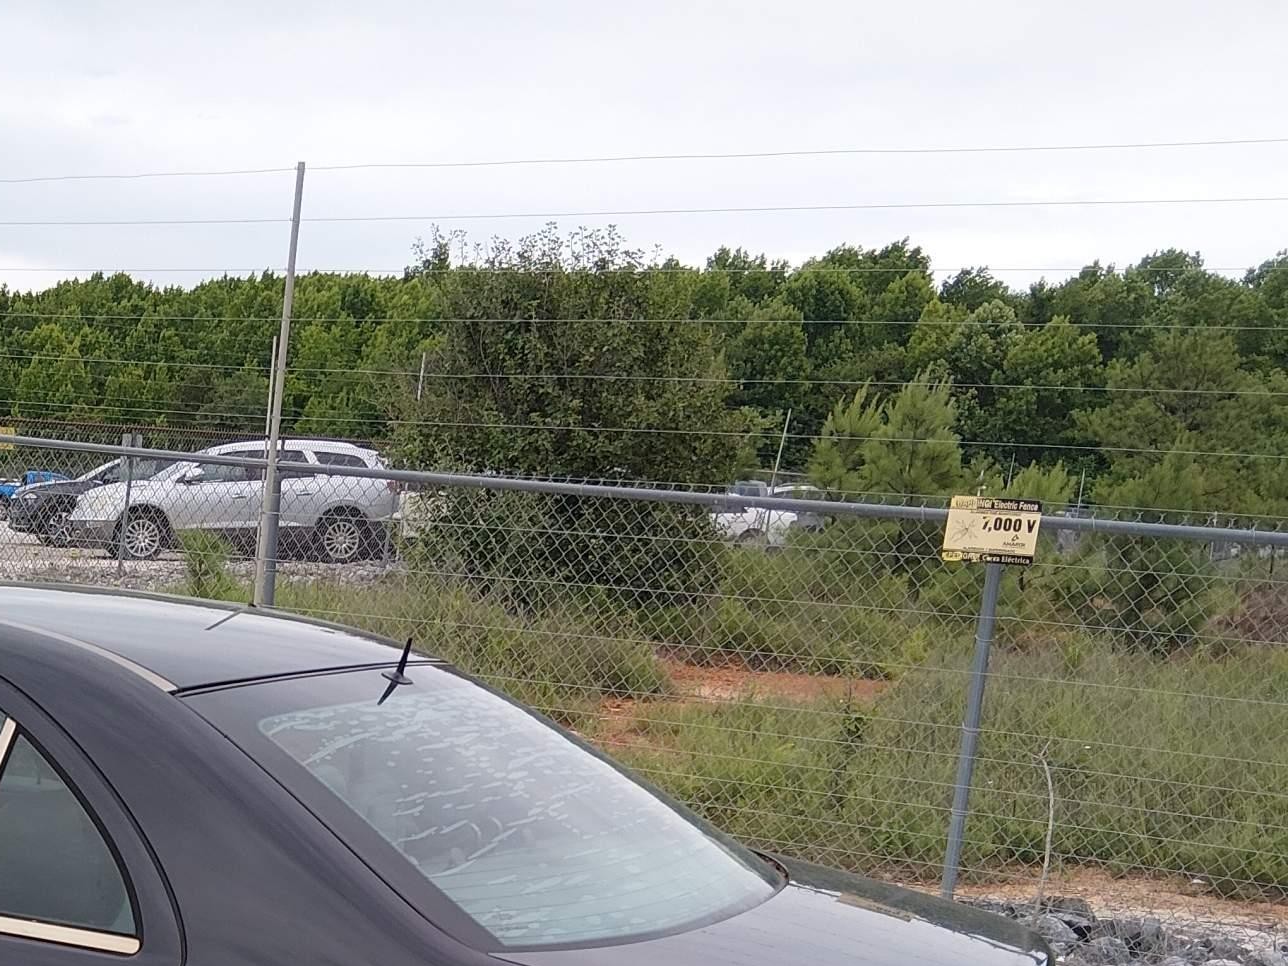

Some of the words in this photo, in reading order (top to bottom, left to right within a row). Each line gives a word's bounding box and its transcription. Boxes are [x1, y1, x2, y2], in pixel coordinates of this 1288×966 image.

[994, 500, 1018, 510] Electric
[1018, 502, 1039, 512] Fence
[982, 516, 1022, 533] 7,000
[1026, 519, 1037, 534] V
